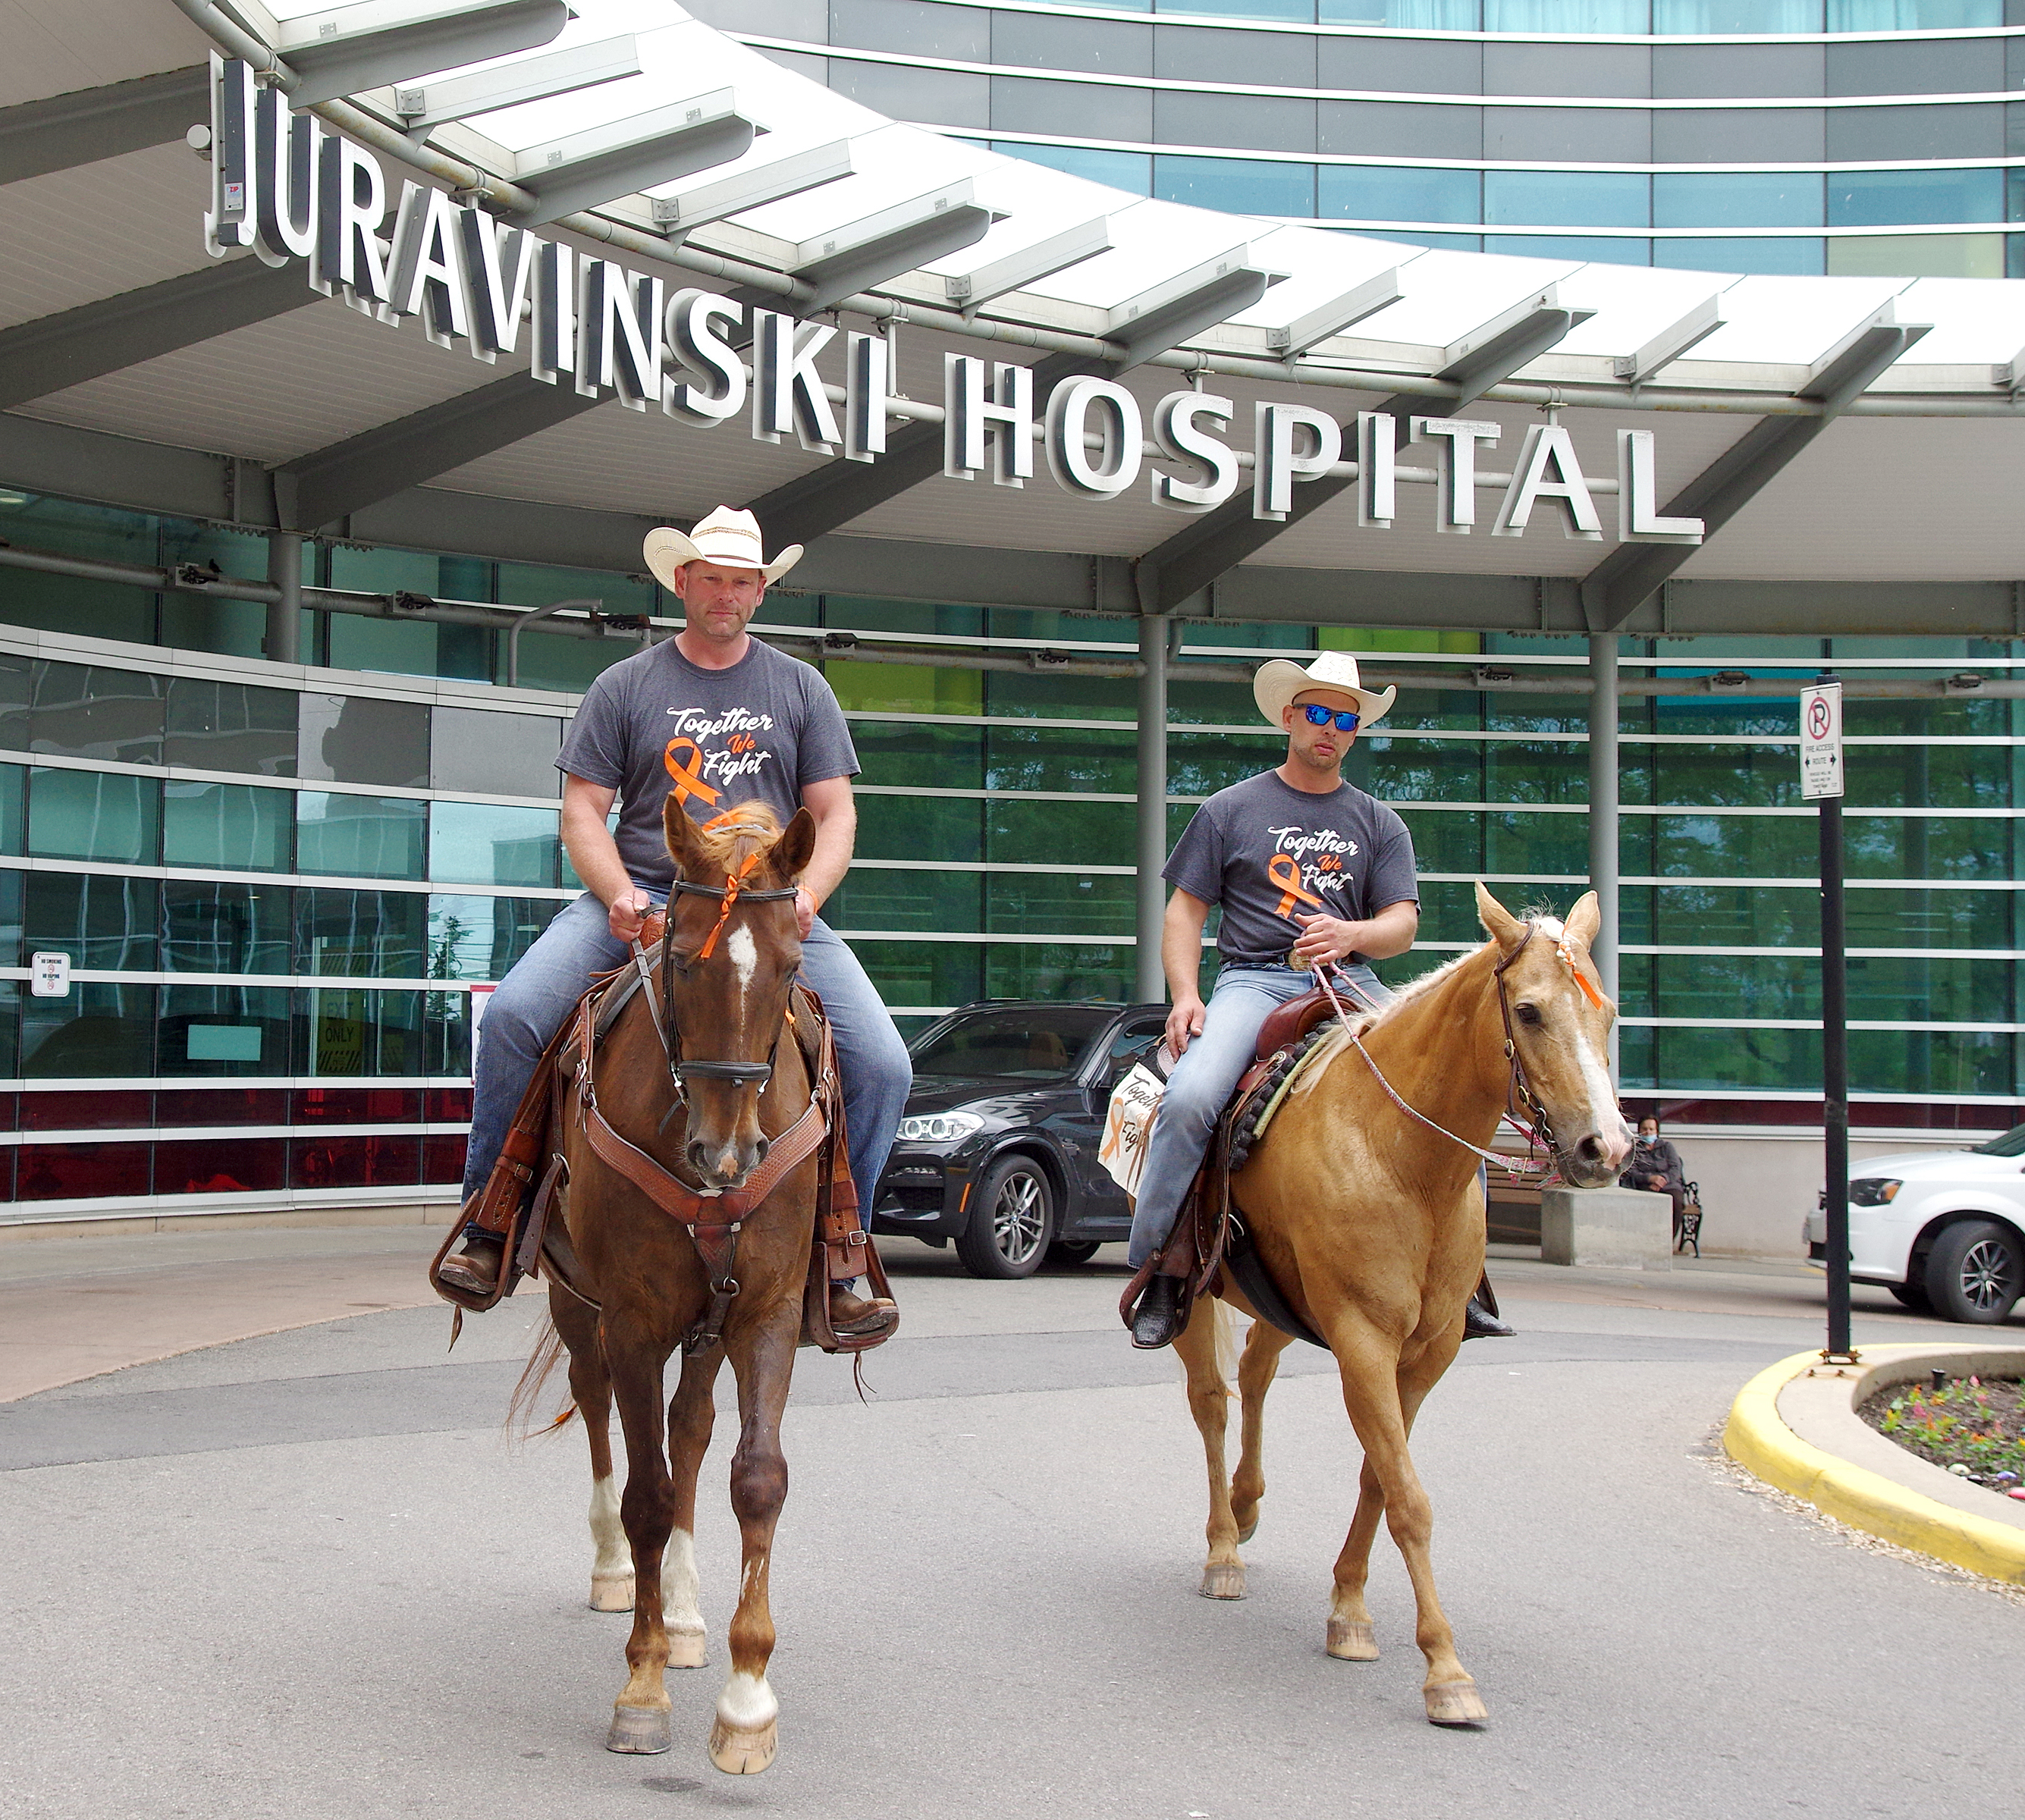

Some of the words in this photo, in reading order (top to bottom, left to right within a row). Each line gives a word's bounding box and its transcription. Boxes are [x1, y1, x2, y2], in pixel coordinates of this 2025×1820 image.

[205, 49, 889, 463] JURAVINSKI
[944, 352, 1705, 545] HOSPITAL
[667, 707, 774, 744] Together
[727, 732, 756, 754] We
[703, 748, 772, 786] Fight
[1267, 826, 1358, 861] Together
[1301, 863, 1354, 894] Fight
[1317, 855, 1342, 871] We
[325, 1027, 354, 1043] ONLY
